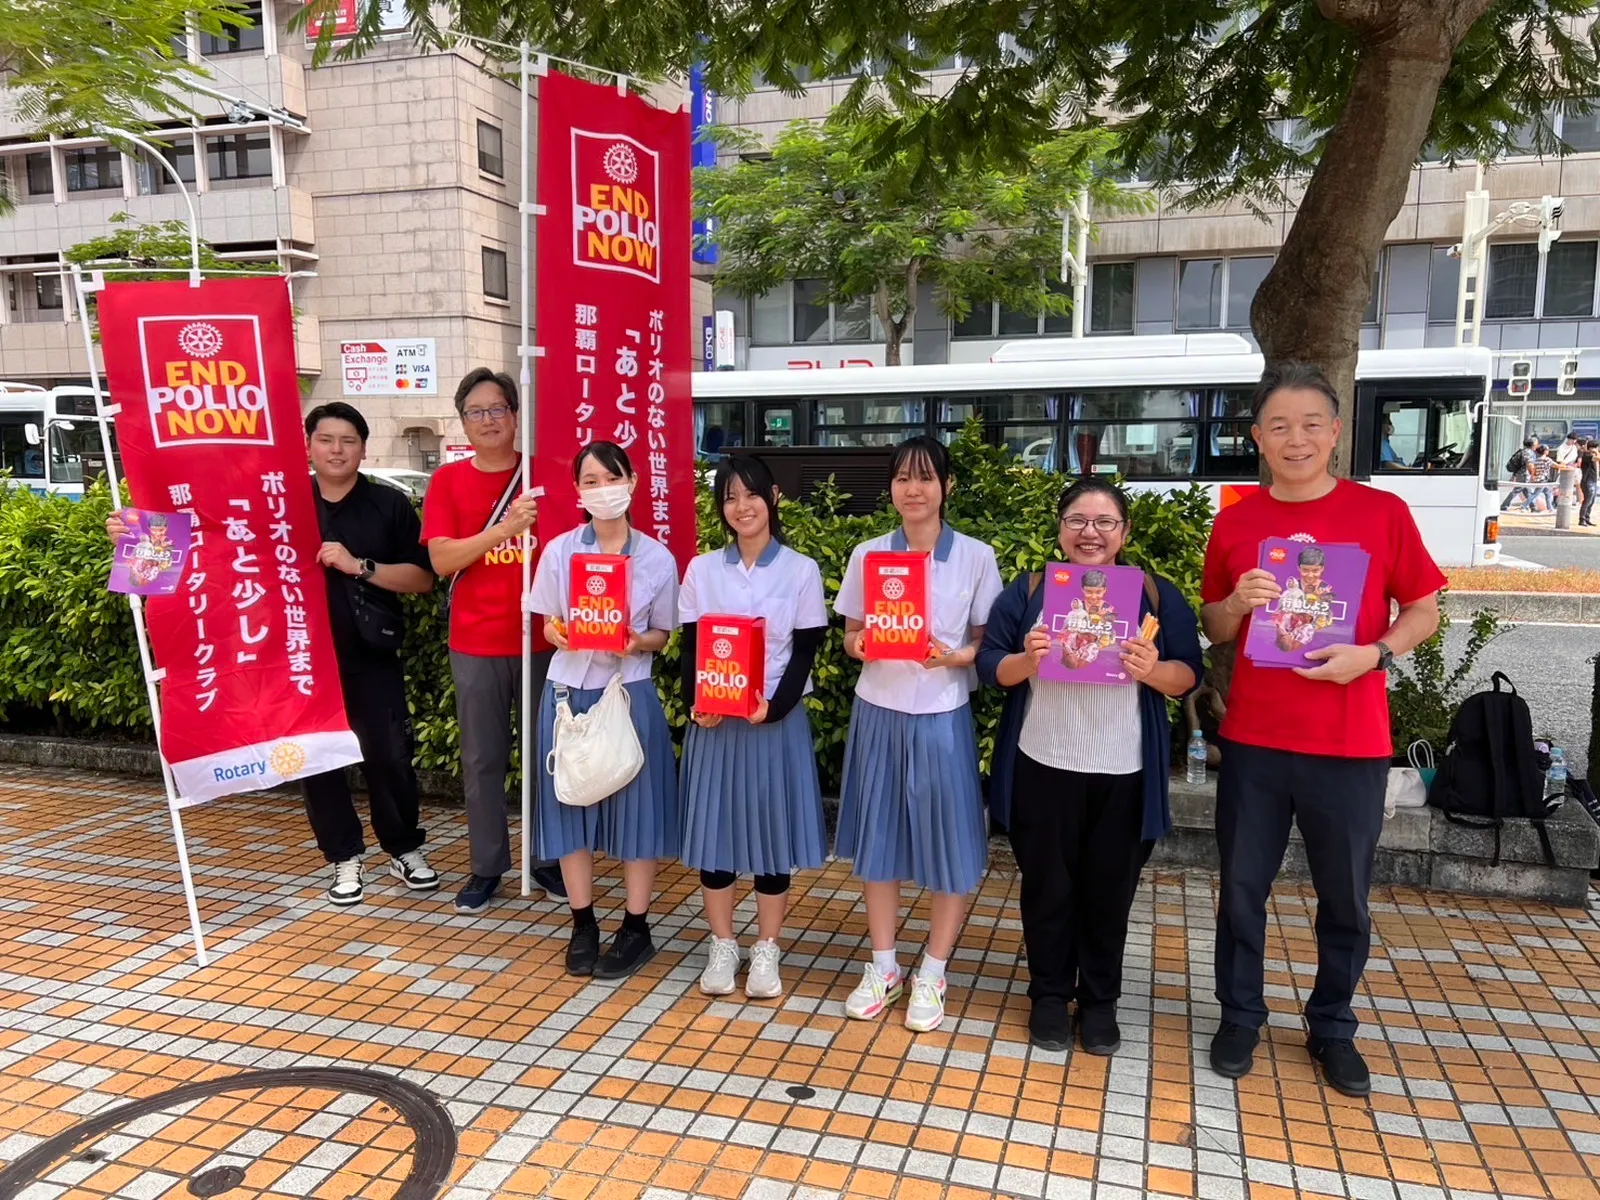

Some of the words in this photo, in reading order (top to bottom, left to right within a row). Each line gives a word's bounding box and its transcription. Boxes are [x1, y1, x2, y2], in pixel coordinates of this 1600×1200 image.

[589, 183, 649, 220] END
[576, 203, 657, 249] POLIO
[587, 231, 653, 270] NOW
[343, 344, 366, 353] Cash
[396, 349, 416, 357] ATM
[344, 354, 388, 366] Exchange
[412, 364, 430, 373] VISA
[165, 360, 247, 387] END
[149, 384, 265, 414] POLIO
[166, 408, 258, 437] NOW
[647, 309, 672, 545] ポリオのない世界まで
[221, 498, 269, 664] 「あと少し」
[260, 471, 314, 696] ポリオのない世界まで
[577, 595, 616, 611] END
[873, 600, 915, 616] END
[569, 607, 623, 624] POLIO
[865, 613, 924, 630] POLIO
[575, 620, 618, 636] NOW
[871, 627, 918, 644] NOW
[704, 658, 741, 676] END
[696, 669, 748, 689] POLIO
[701, 682, 742, 701] NOW
[213, 760, 266, 782] Rotary
